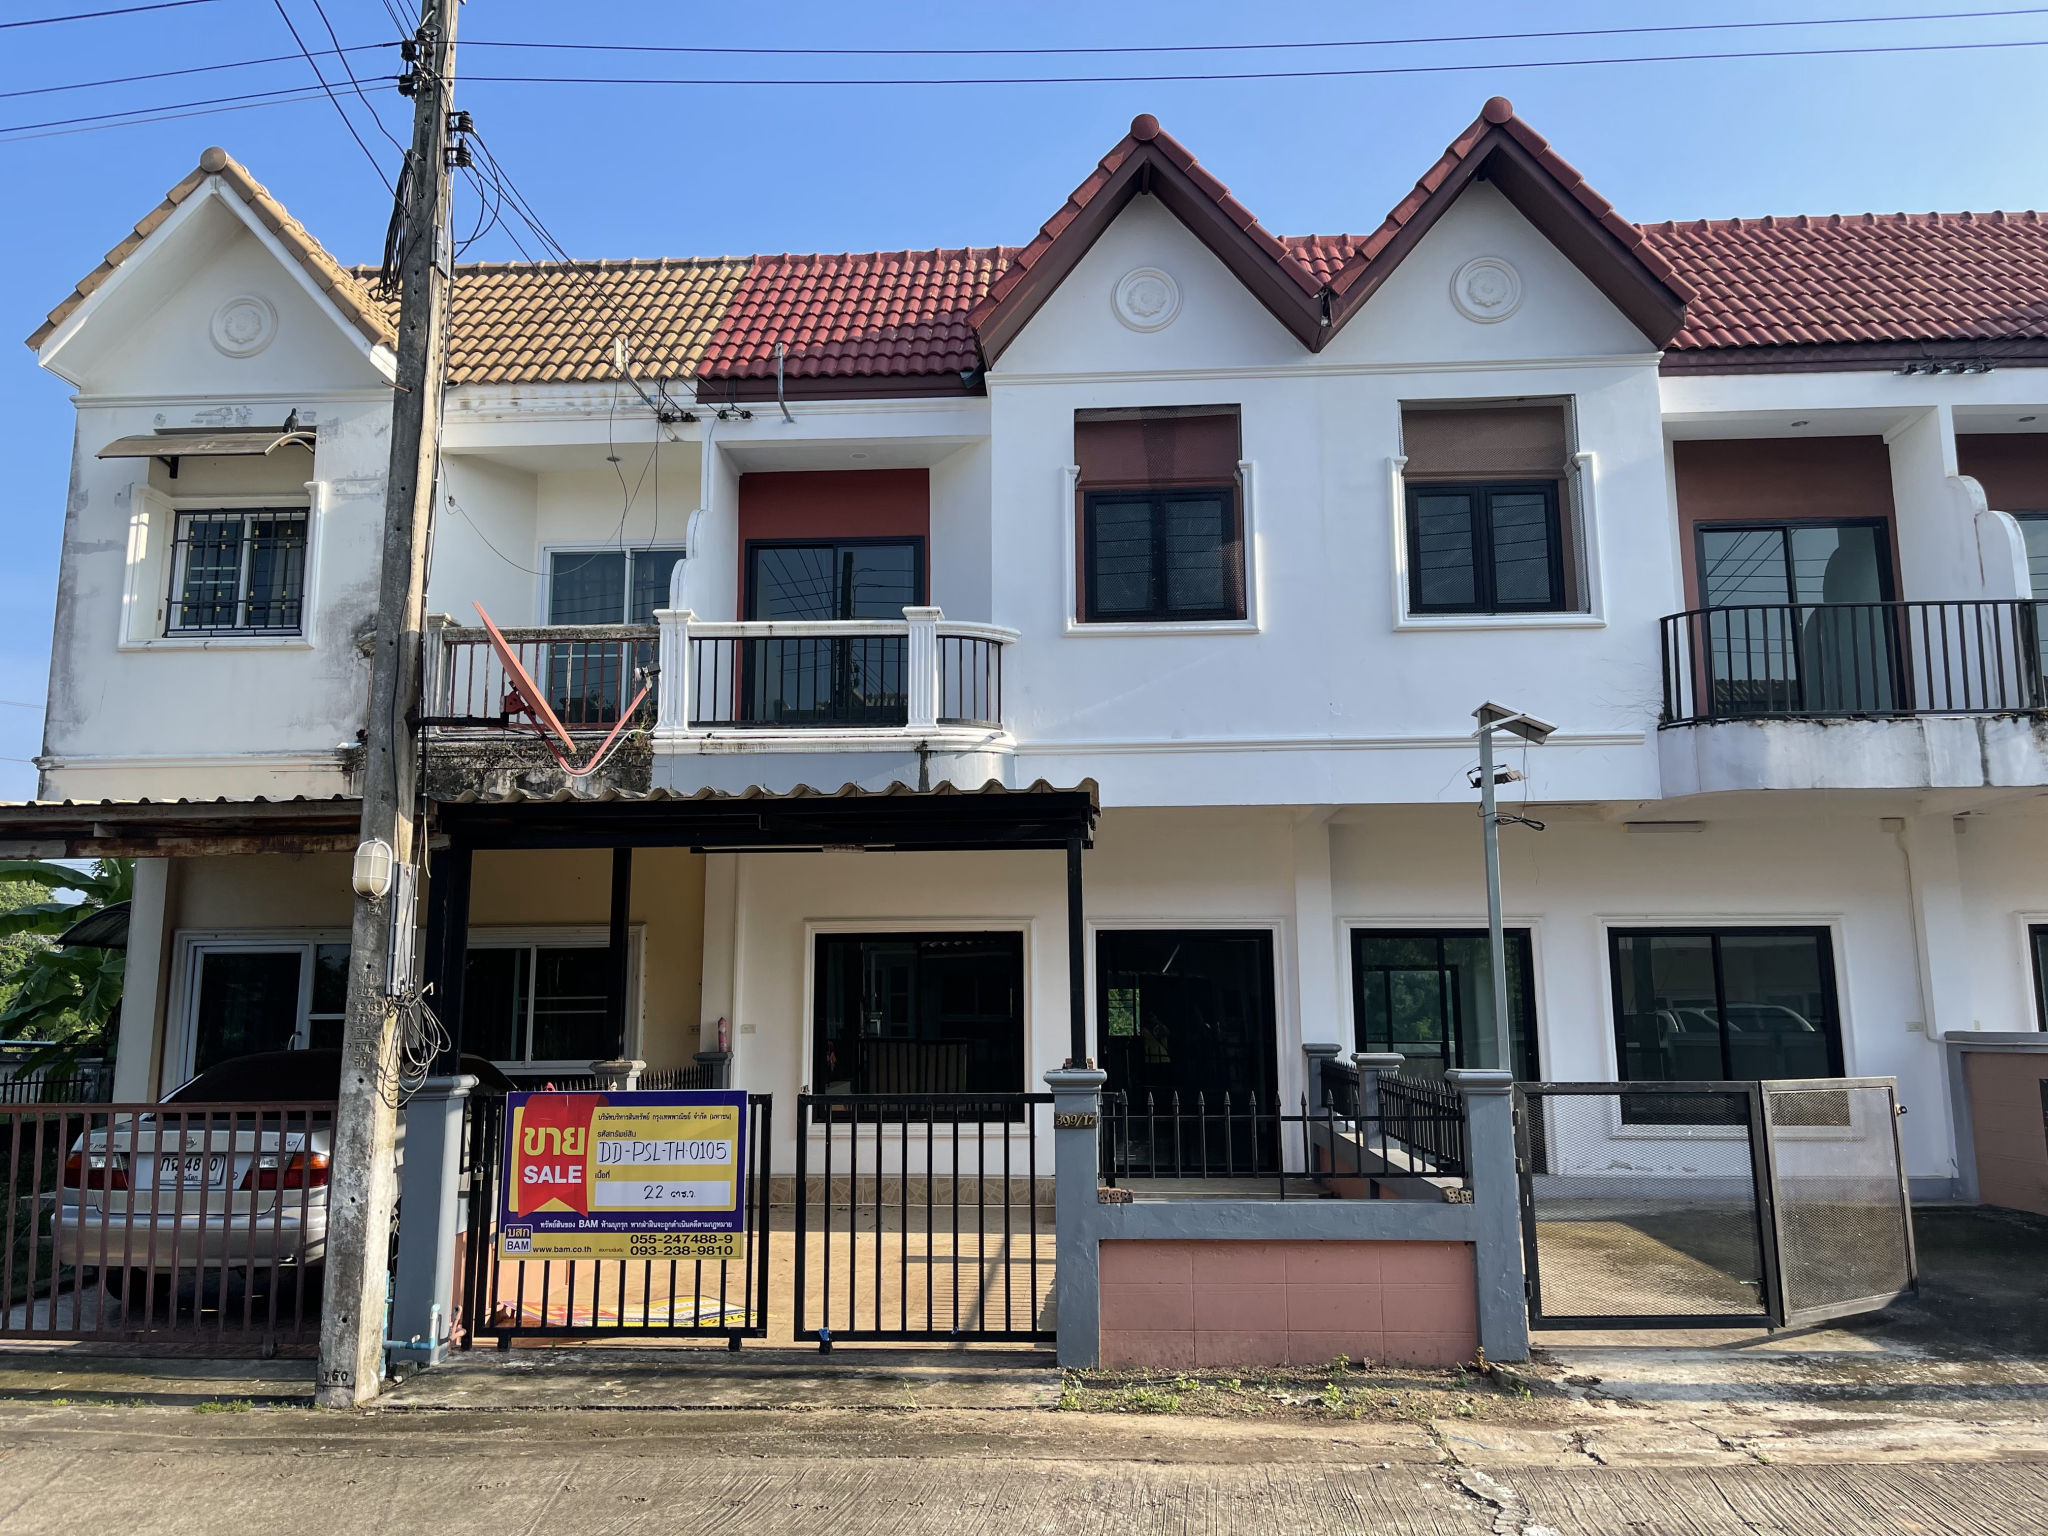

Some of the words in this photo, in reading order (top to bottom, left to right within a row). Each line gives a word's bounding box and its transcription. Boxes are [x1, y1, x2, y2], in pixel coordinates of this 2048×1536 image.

[1056, 1113, 1096, 1127] 399/17
[524, 1127, 585, 1155] ขาย
[185, 1157, 218, 1171] 480
[523, 1165, 583, 1184] SALE
[643, 1185, 664, 1200] 22
[578, 1219, 598, 1228] BAM
[507, 1228, 530, 1238] บสก
[630, 1234, 733, 1244] 055-247488-9
[506, 1240, 529, 1250] BAM
[630, 1246, 733, 1256] 093-238-9810
